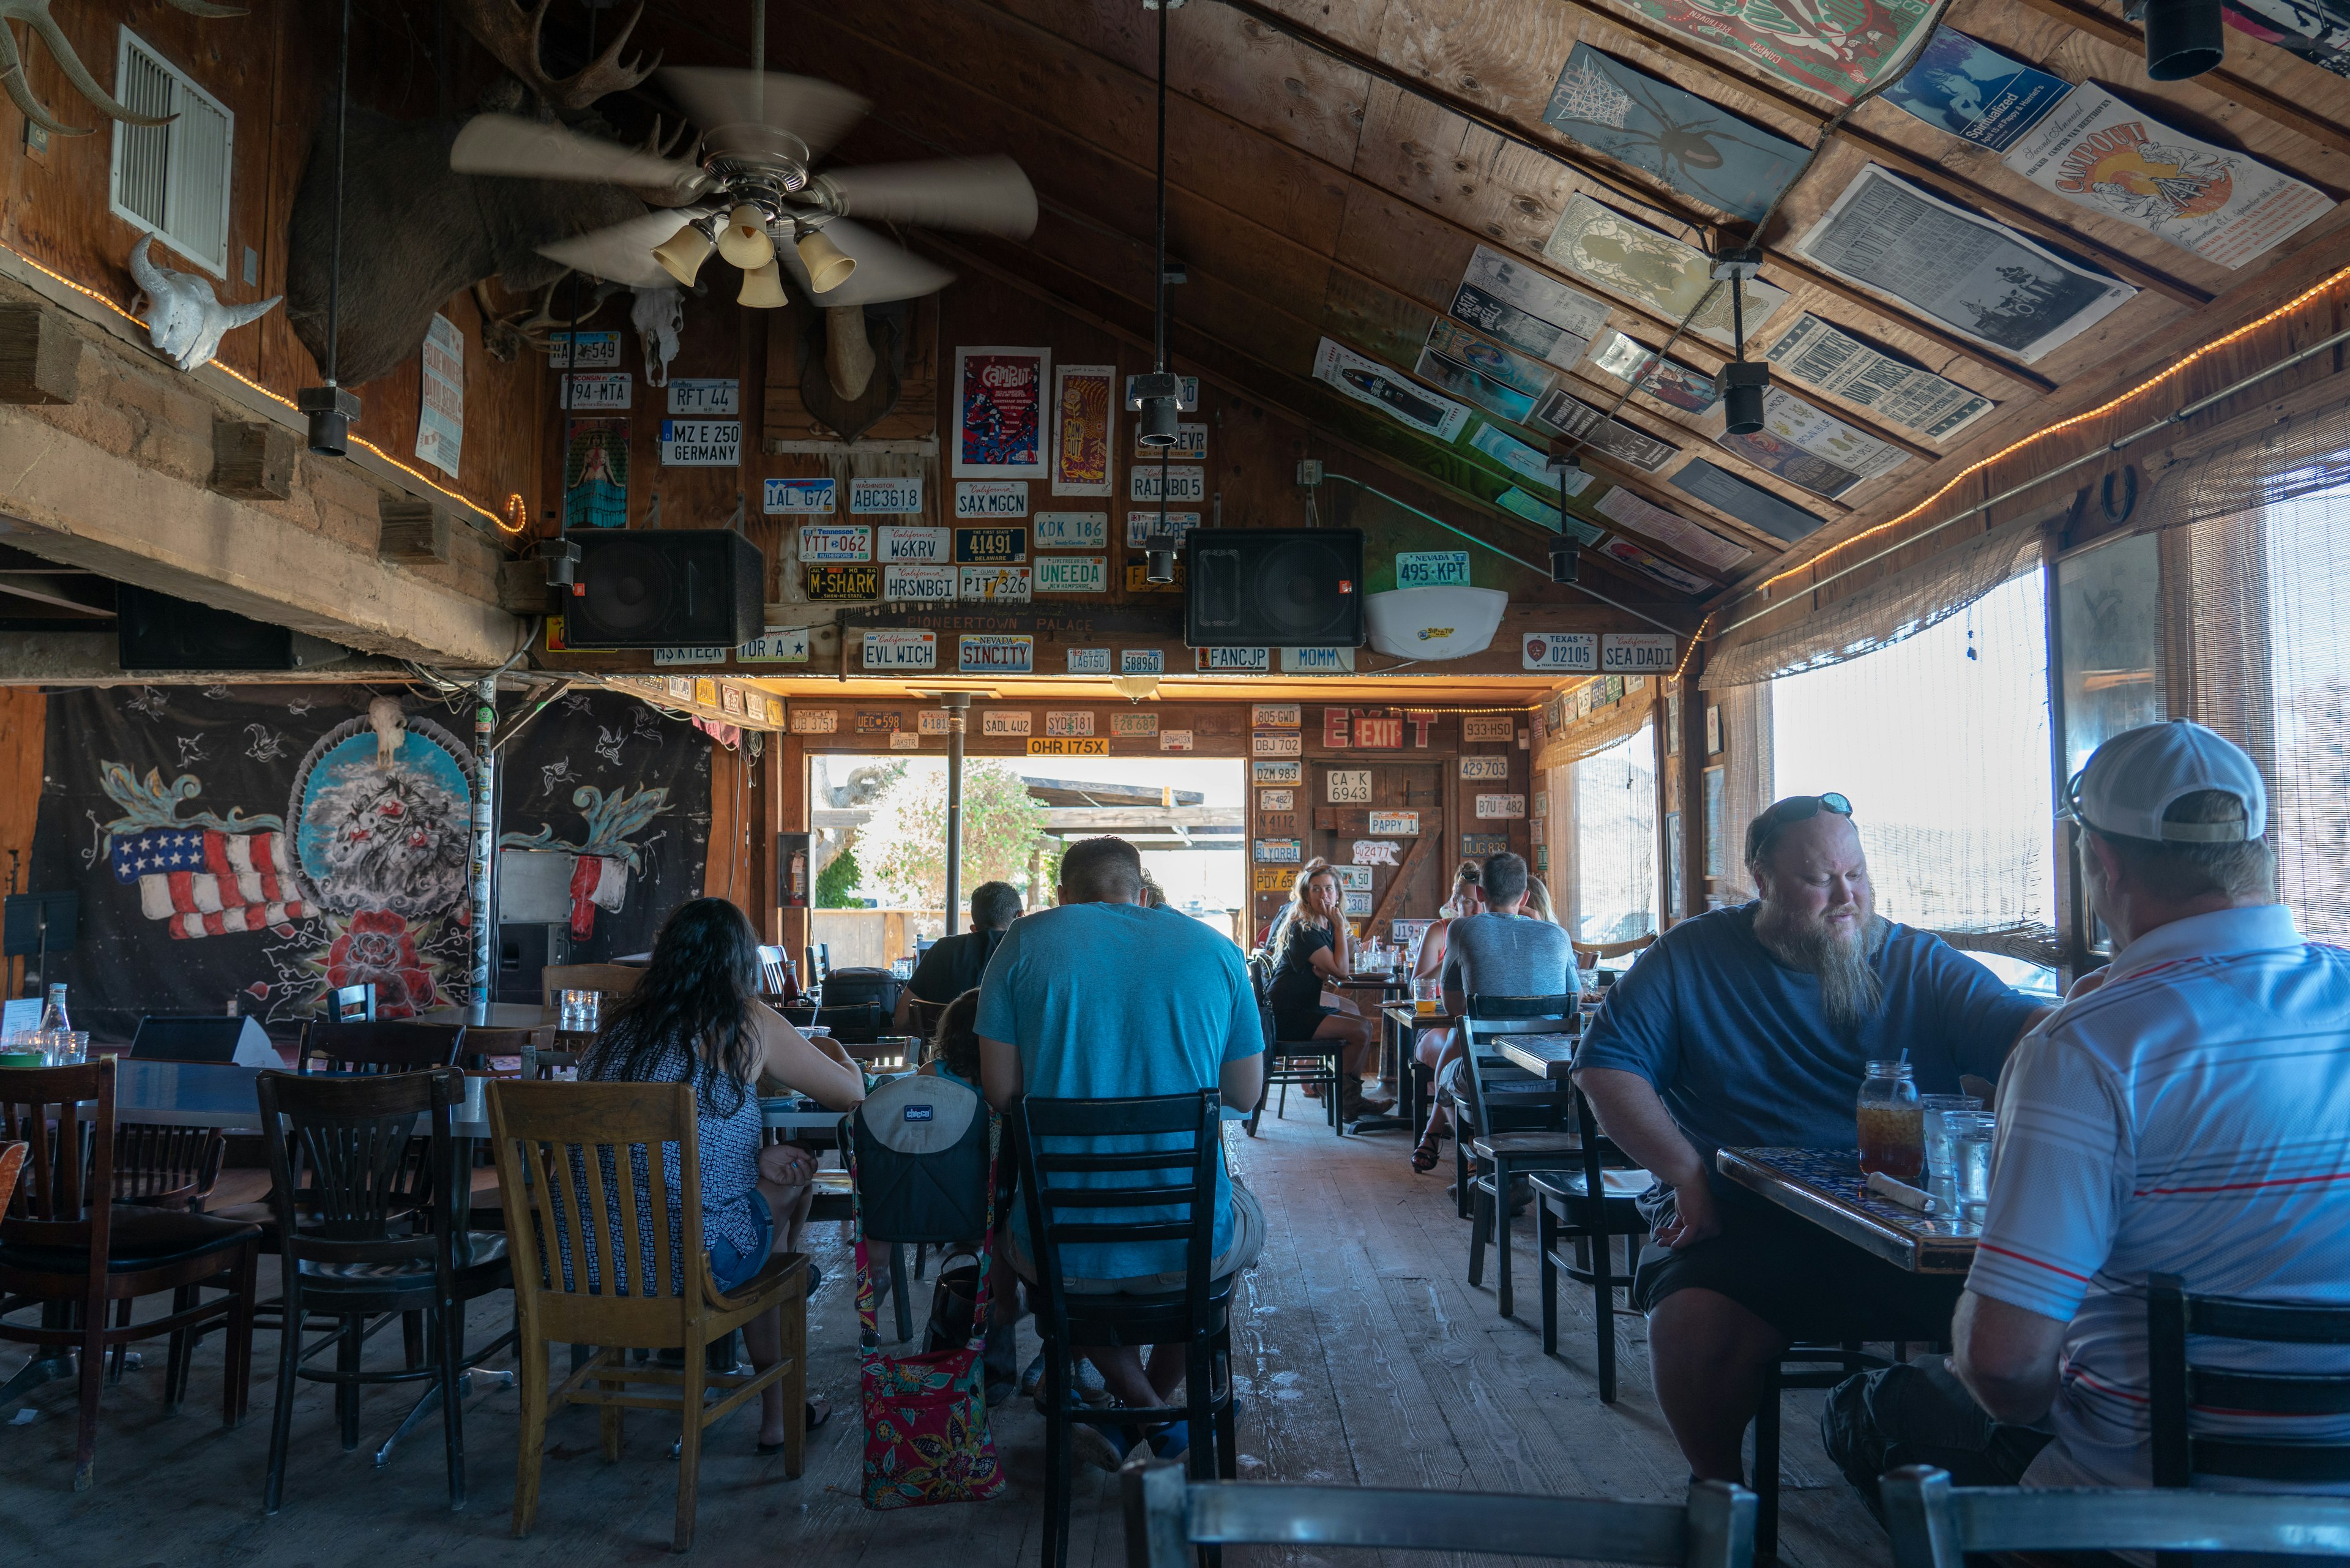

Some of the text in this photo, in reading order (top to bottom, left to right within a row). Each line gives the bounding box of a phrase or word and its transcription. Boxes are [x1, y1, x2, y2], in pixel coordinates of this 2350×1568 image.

[1689, 10, 1733, 34] BEETHOVEN
[1750, 39, 1781, 64] CAMPER
[1966, 92, 2020, 139] Spiritualized
[1981, 85, 2045, 143] April 15 Pappy Harriet's
[2023, 102, 2084, 160] Second Annual
[2026, 98, 2111, 176] CRACKER CAMPER VAN BEETHOVEN
[2056, 121, 2149, 193] CAMPOUT
[2232, 197, 2259, 218] September
[1813, 243, 1836, 269] NORTH
[1859, 182, 1903, 220] ALLSTARS
[2196, 182, 2300, 253] CRACKER CAMPER VAN BEETHOVEN
[1835, 195, 1935, 280] KEYS TO THE KINGDOM
[1457, 292, 1479, 318] DEATH
[1479, 303, 1502, 330] WHEELS
[592, 342, 614, 357] 549
[1835, 351, 1875, 384] VERY SPECIAL GUESTS
[1840, 359, 1913, 405] DARK HORSES
[677, 389, 728, 405] RFT 44
[1770, 393, 1788, 409] MOON
[1551, 398, 1575, 425] SPINDRIFT
[674, 426, 739, 442] MZ E 250
[1067, 420, 1083, 439] CAMP
[1797, 419, 1833, 444] BROWN BLUE
[675, 446, 736, 460] GERMANY
[1067, 439, 1081, 457] OUT
[1860, 444, 1875, 456] SPLIT
[971, 485, 1011, 495] California
[1192, 479, 1199, 495] 5
[767, 490, 832, 506] 1AL G72
[854, 490, 917, 507] ABC3618
[960, 495, 1024, 512] SAX MGCN
[893, 529, 934, 540] California
[1039, 521, 1102, 537] KDK 186
[804, 536, 865, 551] YTT 062
[892, 540, 935, 557] W6KRV
[969, 535, 1011, 553] 41491
[901, 569, 942, 579] California
[1042, 566, 1099, 583] UNEEDA
[810, 574, 875, 593] M-SHARK
[889, 579, 952, 596] HRSNBGI
[908, 616, 1093, 632] PIONEERTOWN PALACE
[776, 640, 783, 656] A
[879, 635, 920, 645] California
[1618, 637, 1660, 647] California
[867, 646, 932, 662] EVL WICH
[964, 646, 1028, 663] SINCITY
[1073, 656, 1104, 668] 1A6750
[1211, 649, 1266, 665] FANCJP
[1299, 649, 1335, 666] MOMM
[1553, 646, 1589, 662] 02105
[1606, 648, 1673, 665] SEA DADI
[1125, 656, 1159, 670] 588960
[811, 718, 834, 730] 3751
[858, 715, 900, 728] UEC 598
[985, 720, 1028, 732] SADL 4U2
[1049, 717, 1091, 730] SYD 181
[1120, 720, 1155, 730] 28 689
[1361, 720, 1398, 746] EXIT
[1032, 741, 1104, 753] OHR 175X
[1256, 739, 1297, 750] DBJ 702
[1257, 769, 1296, 779] DZM 983
[1332, 772, 1367, 786] CA K
[1333, 787, 1367, 800] 6943
[1479, 801, 1496, 813] B7U
[1507, 801, 1523, 813] 482
[1269, 815, 1294, 828] 4112
[1373, 820, 1414, 831] PAPPY 1
[1365, 847, 1389, 857] 2477
[1464, 842, 1506, 854] UJG 839
[1257, 875, 1278, 888] PDY
[1359, 873, 1368, 885] 50
[1395, 925, 1414, 938] J19
[907, 1108, 930, 1119] chicco
